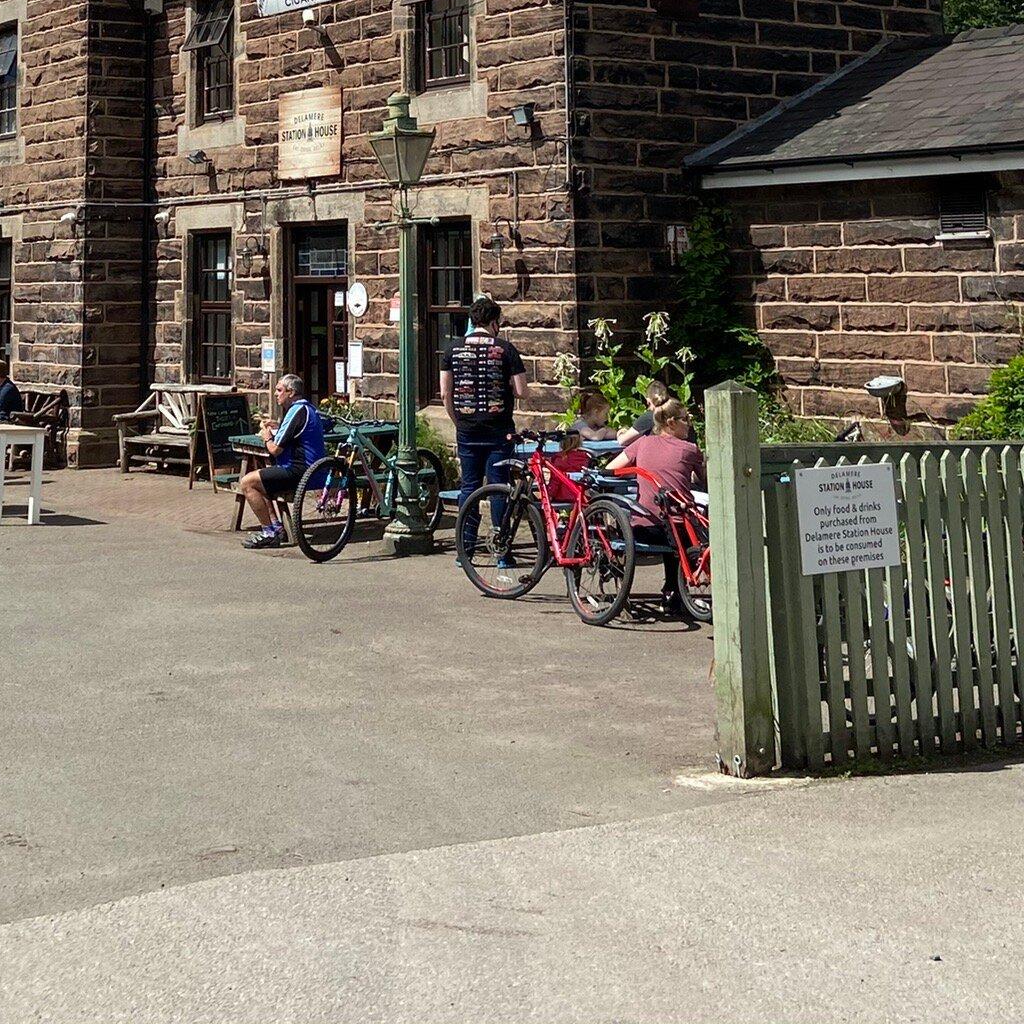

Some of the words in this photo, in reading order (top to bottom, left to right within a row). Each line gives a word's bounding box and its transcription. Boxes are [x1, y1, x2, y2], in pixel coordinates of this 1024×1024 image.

[293, 112, 324, 125] DELAMERE
[281, 128, 307, 142] STATION
[314, 124, 338, 138] HOUSE
[831, 471, 861, 479] DELAMERE
[818, 481, 845, 492] STATION
[852, 479, 874, 490] HOUSE
[813, 506, 832, 516] Only
[833, 504, 851, 514] food
[852, 505, 858, 513] &
[859, 502, 882, 512] drinks
[820, 517, 858, 529] purchased
[859, 515, 877, 524] from
[805, 532, 841, 542] Delamere
[842, 529, 869, 539] Station
[871, 527, 893, 536] House
[817, 545, 824, 553] is
[825, 544, 834, 553] to
[835, 542, 844, 552] be
[845, 538, 883, 551] consumed
[818, 558, 828, 566] on
[829, 555, 850, 565] these
[851, 552, 884, 565] premises
